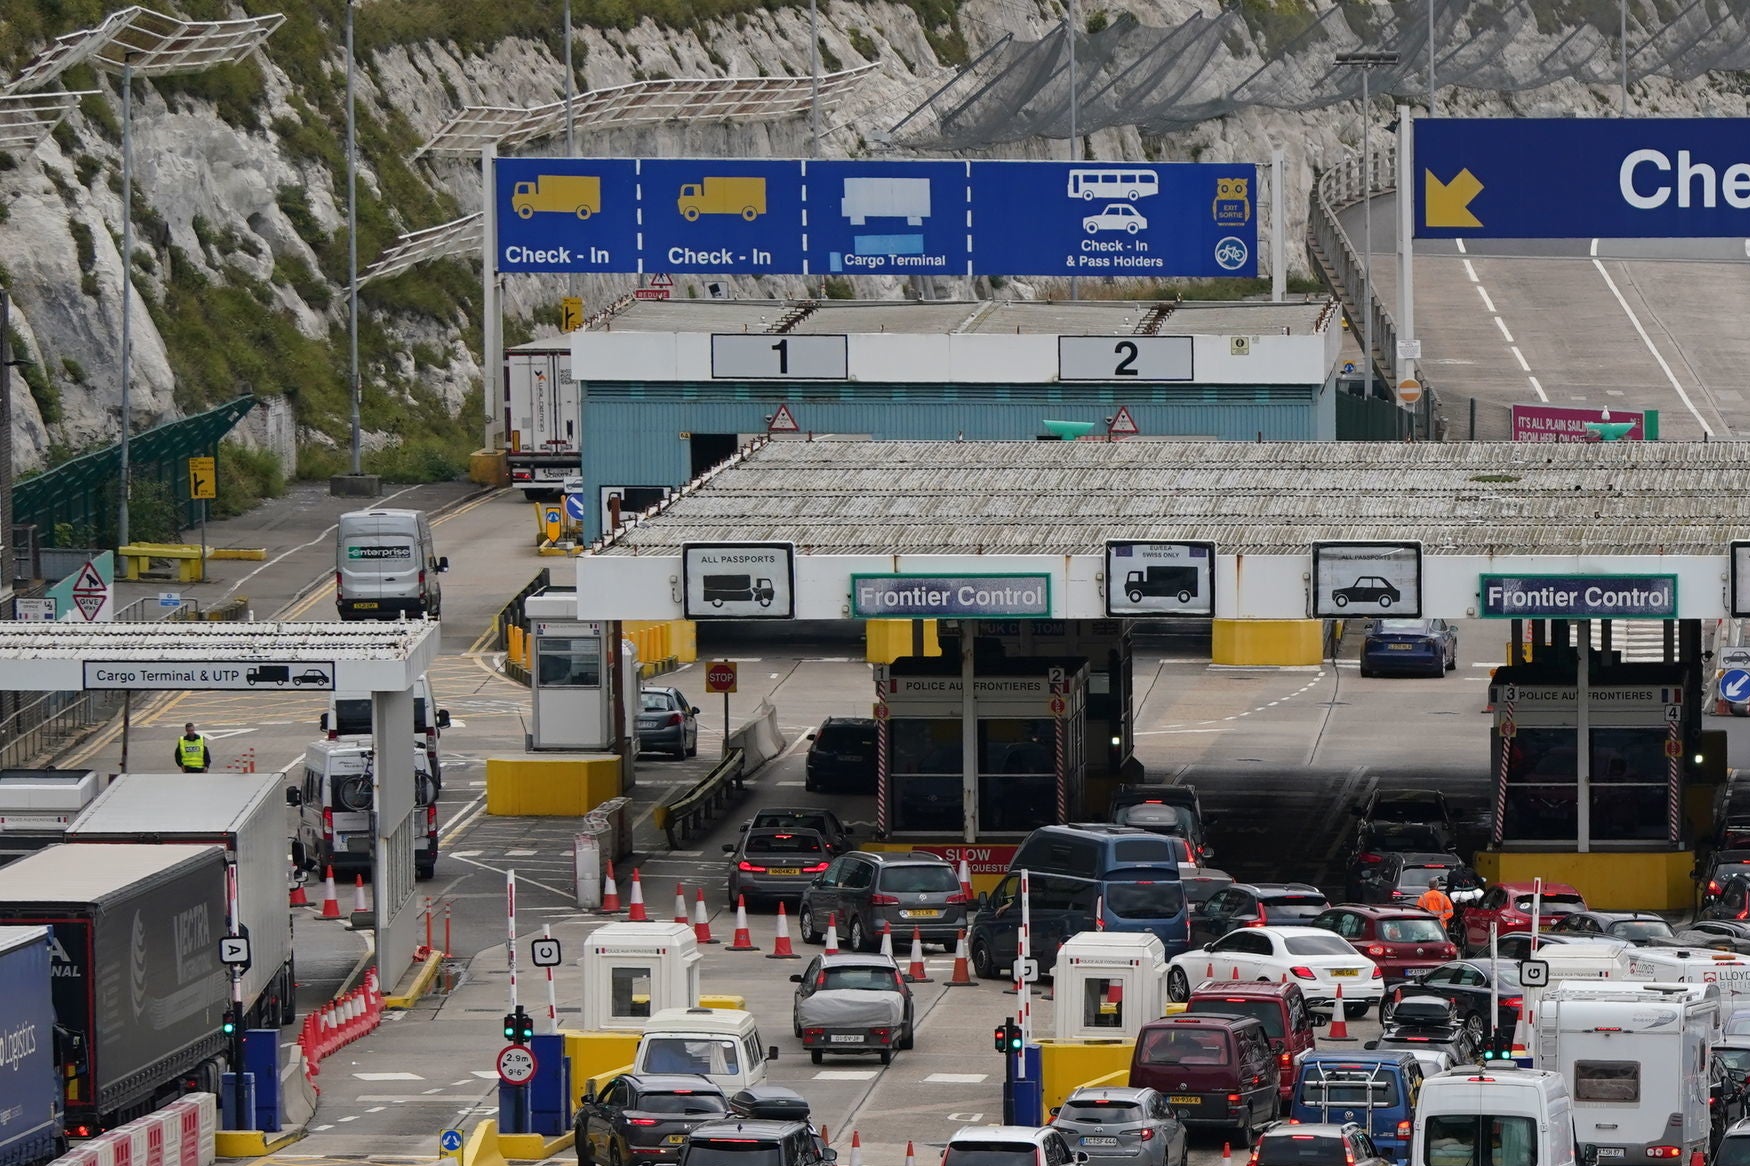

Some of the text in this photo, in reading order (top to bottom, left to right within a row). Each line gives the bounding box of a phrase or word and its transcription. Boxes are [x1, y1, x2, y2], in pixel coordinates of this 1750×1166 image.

[1081, 238, 1121, 252] Check
[1135, 239, 1148, 252] In
[505, 245, 570, 265] Check
[591, 246, 610, 265] In
[668, 246, 733, 265] Check
[752, 247, 772, 266] In
[844, 252, 946, 270] Cargo Terminal
[1066, 256, 1163, 268] & Pass Holders
[770, 339, 789, 374] 1
[1115, 341, 1138, 375] 2
[1518, 416, 1566, 431] IT'S ALL PLAIN
[349, 547, 410, 558] enterprise
[701, 554, 776, 564] ALL PASSPORTS
[80, 598, 99, 606] GIVE
[860, 585, 1043, 608] Frontier Control
[1488, 586, 1670, 608] Frontier Control
[96, 668, 240, 686] Cargo Terminal & UTP
[709, 671, 734, 684] STOP
[877, 665, 886, 680] 1
[1051, 668, 1062, 683] 2
[905, 680, 1042, 692] POLICE FRONTIERES
[1505, 685, 1516, 701] 3
[1518, 690, 1559, 701] POLICE
[1667, 706, 1679, 720] 4
[945, 846, 991, 863] SLOW
[228, 944, 241, 956] A
[540, 946, 552, 958] C
[506, 1053, 529, 1064] 2.9m
